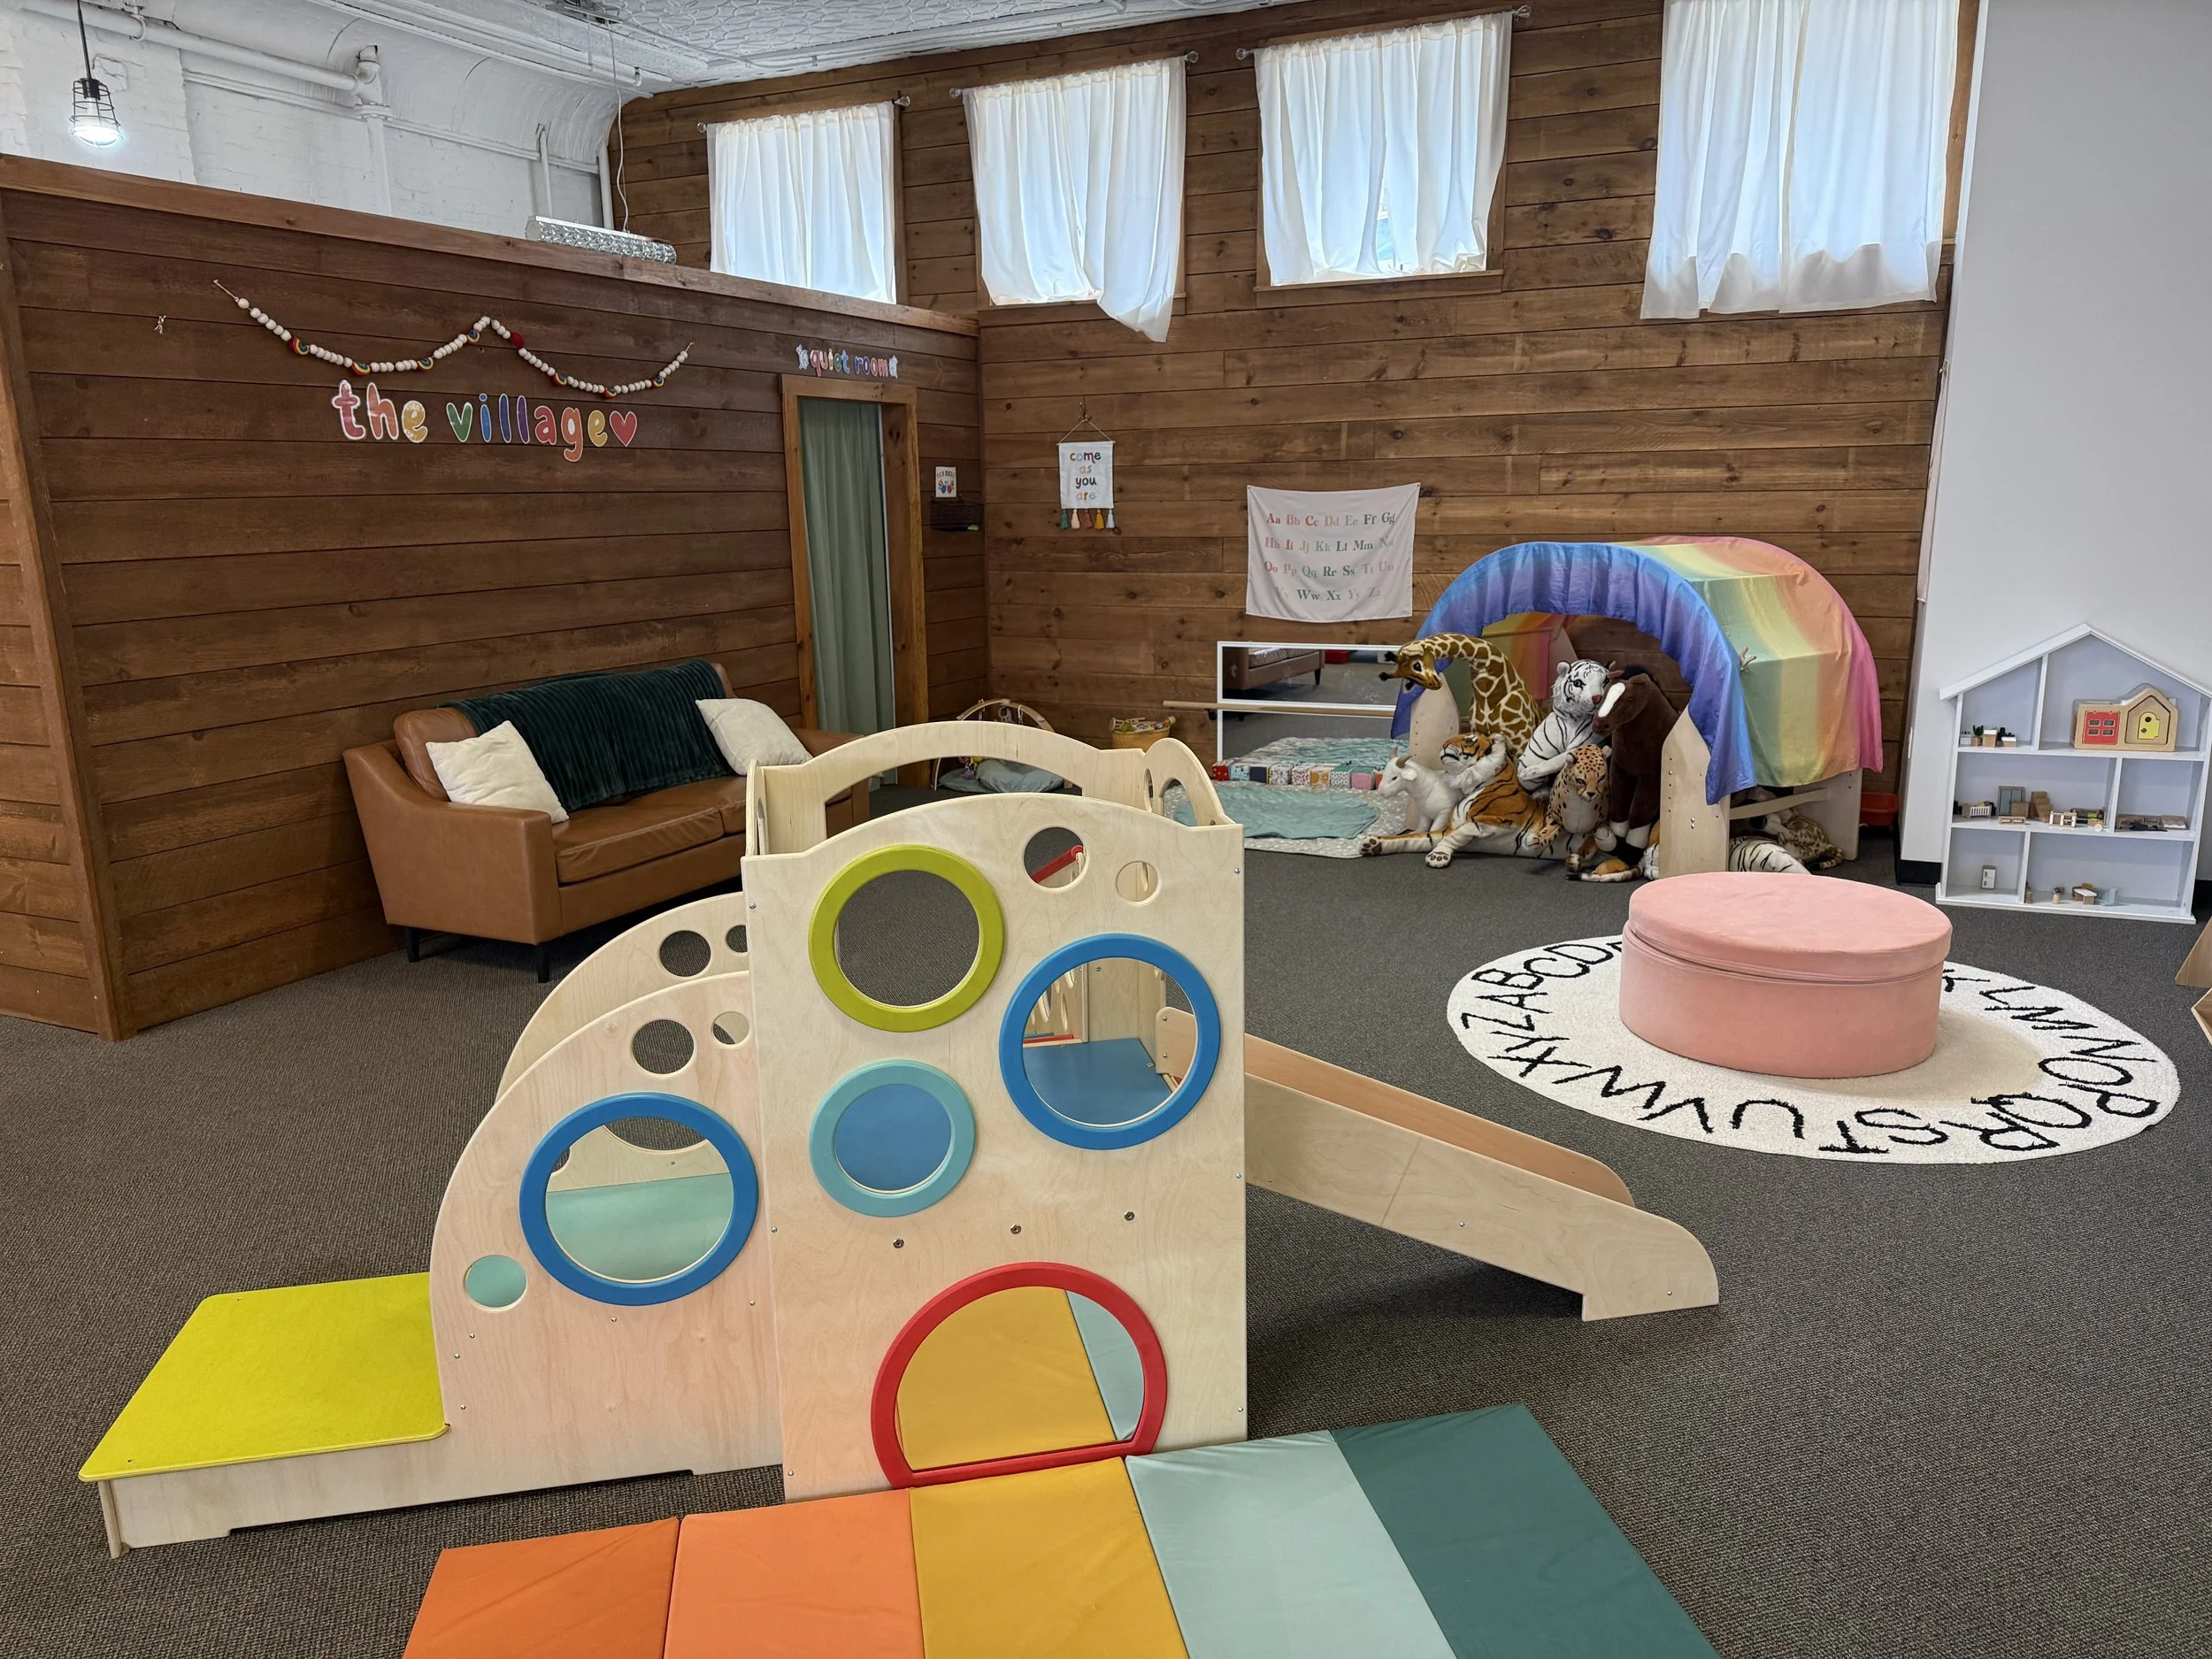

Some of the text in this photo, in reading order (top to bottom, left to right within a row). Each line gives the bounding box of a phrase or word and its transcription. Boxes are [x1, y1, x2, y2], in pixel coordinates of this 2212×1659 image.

[810, 348, 888, 378] quiet room
[332, 380, 608, 462] the village
[1070, 452, 1101, 464] come
[1079, 465, 1092, 473] as
[1076, 477, 1097, 488] you
[1076, 492, 1096, 501] are
[1266, 511, 1395, 526] Aa Bb Cc Dd Ee Ff Gg
[1264, 536, 1280, 549] Hh
[1299, 540, 1310, 553] Jj
[1353, 540, 1374, 550] Mm
[1263, 560, 1279, 573] Oo
[1284, 564, 1297, 577] Pp
[1302, 565, 1317, 579] Qq
[1323, 565, 1337, 577] Rr
[1342, 565, 1356, 576] Ss
[1297, 588, 1320, 601] Ww
[1326, 589, 1341, 601] Xx
